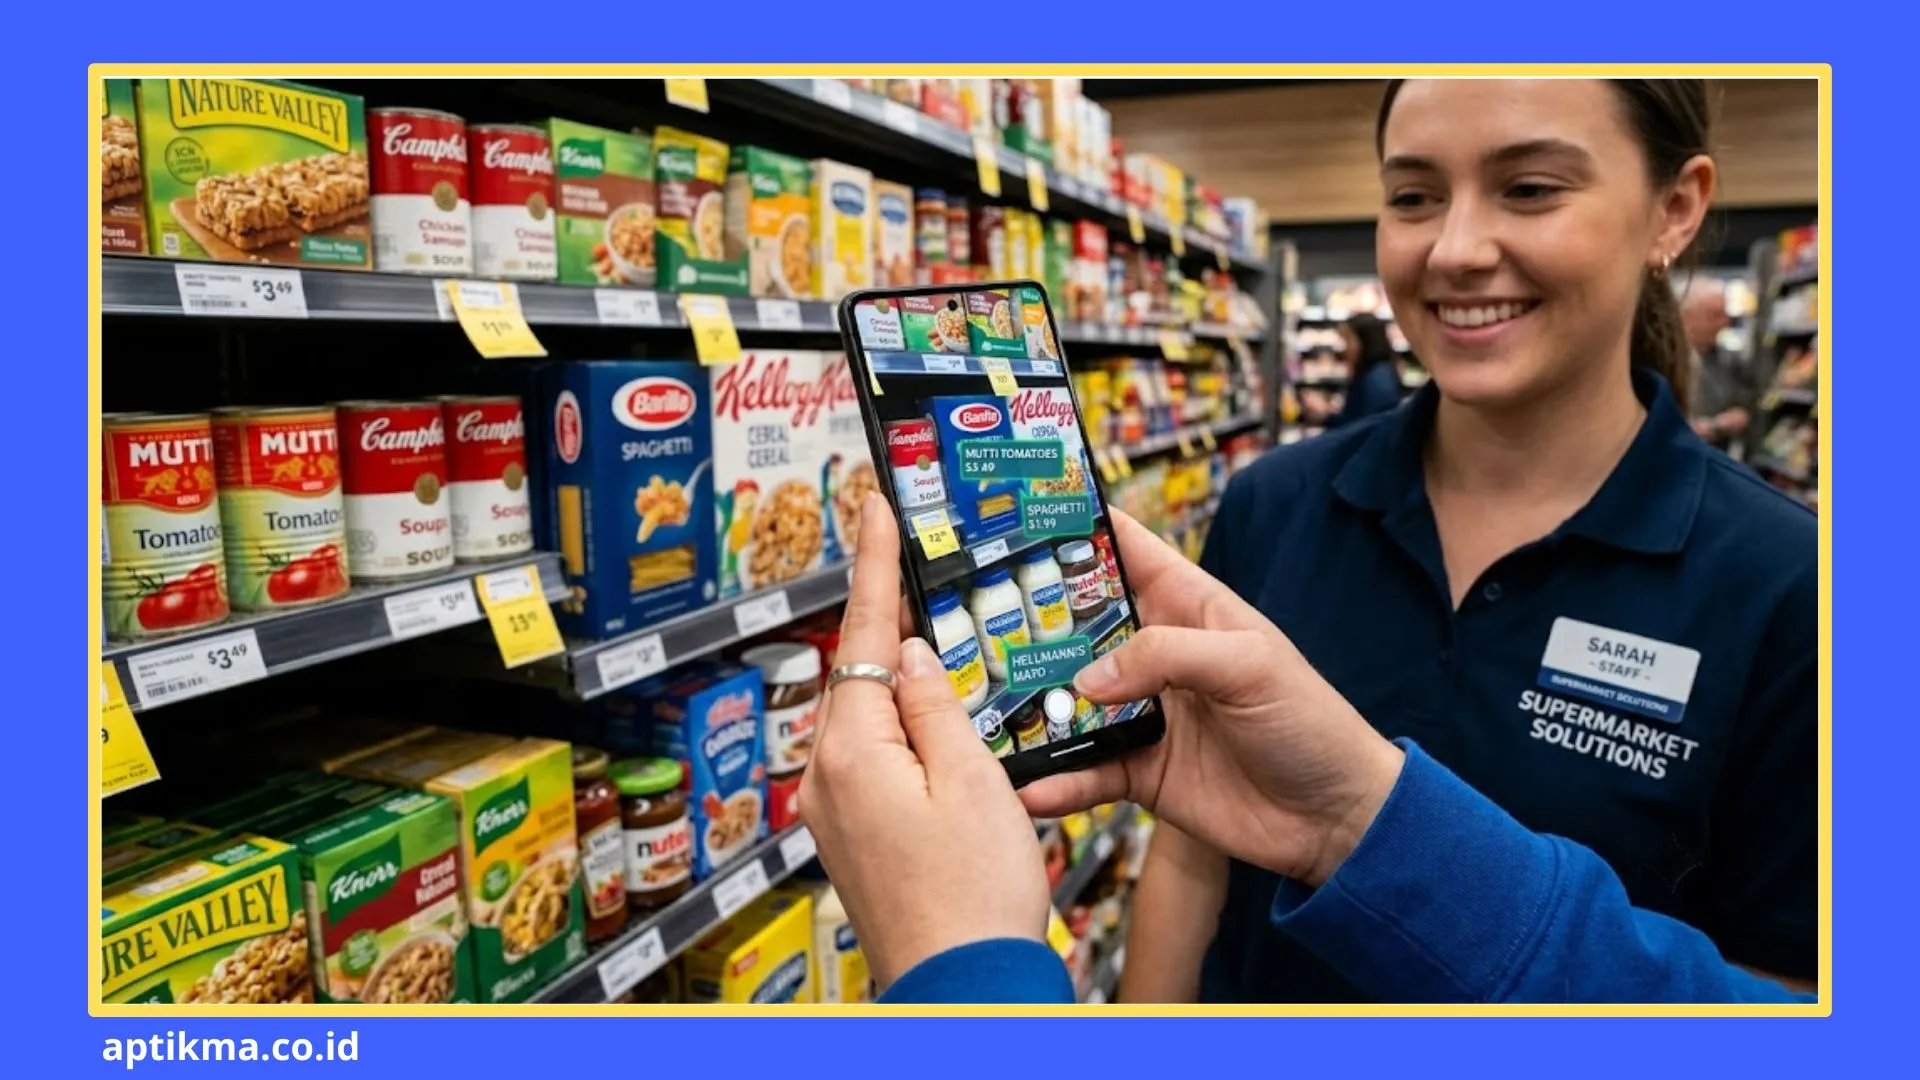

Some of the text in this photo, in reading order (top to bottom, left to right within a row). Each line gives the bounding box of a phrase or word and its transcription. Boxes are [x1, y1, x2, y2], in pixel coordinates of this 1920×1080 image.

[178, 79, 343, 143] NATURE VALLEY
[621, 436, 693, 461] SPAGHETTI
[965, 448, 1058, 459] MUTTI TOMATOES
[1027, 503, 1086, 516] SPAGHETTI
[1587, 637, 1657, 667] SARAH
[1598, 660, 1641, 680] STAFF
[1616, 692, 1670, 714] SOLUTIONS
[1518, 689, 1700, 761] SUPERMARKET
[1530, 718, 1669, 779] SOLUTIONS
[329, 861, 400, 904] Knorr
[159, 874, 277, 951] VALLEY
